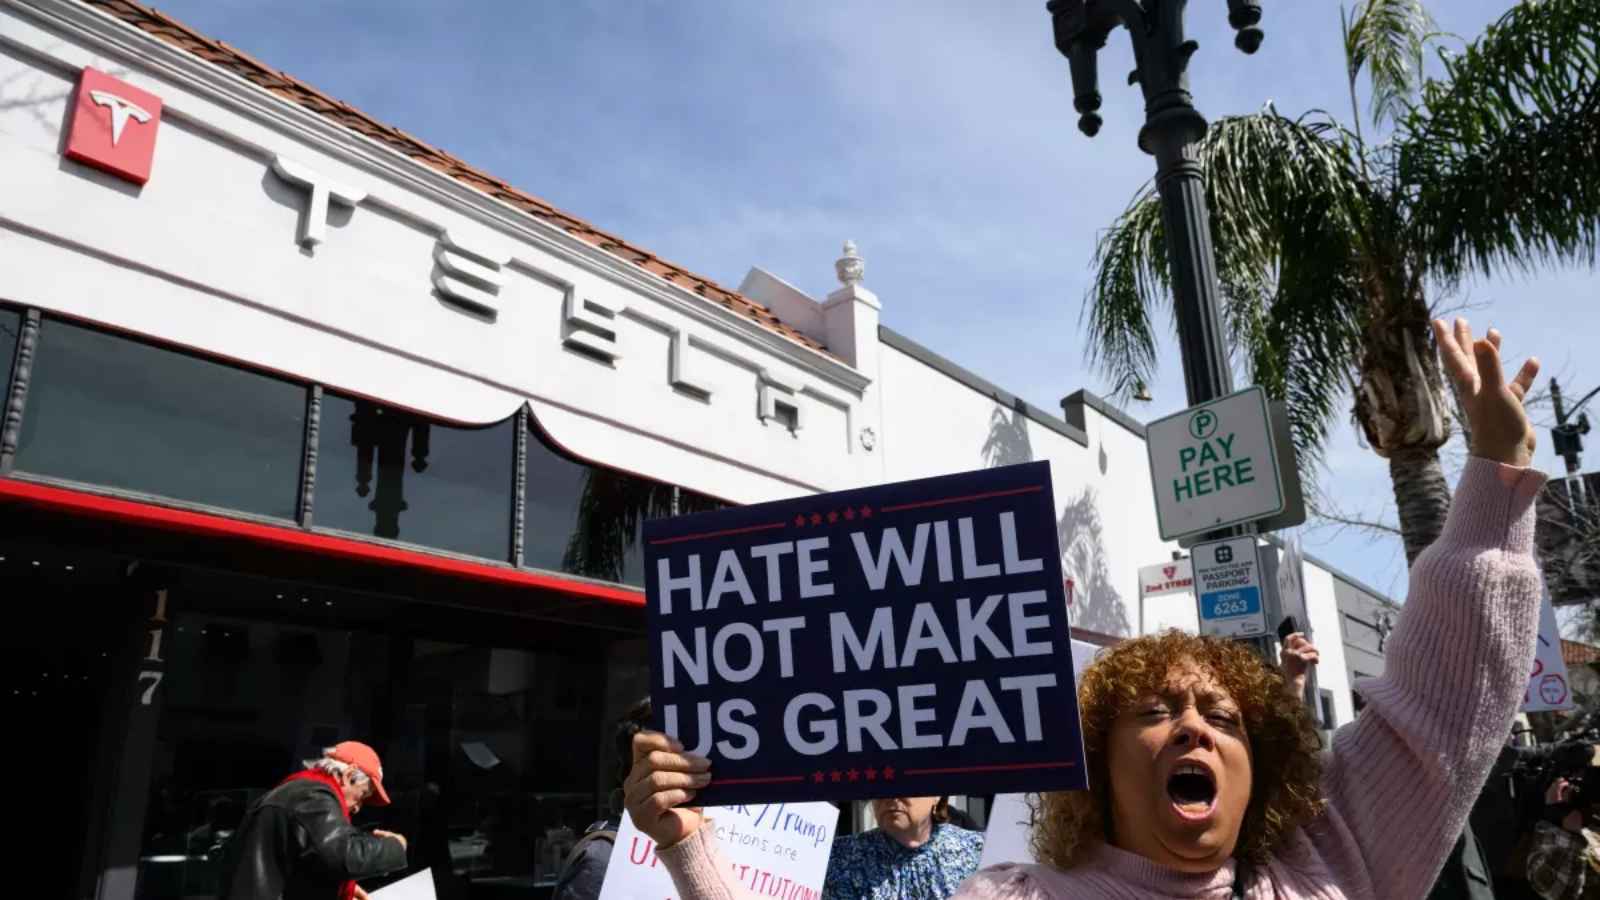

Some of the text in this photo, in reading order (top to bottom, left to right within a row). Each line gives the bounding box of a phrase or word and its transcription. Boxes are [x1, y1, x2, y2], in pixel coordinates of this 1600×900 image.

[270, 153, 805, 435] TESLA
[1179, 432, 1235, 472] PAY
[1173, 457, 1255, 502] HERE
[656, 511, 1044, 615] HATE WILL
[1203, 568, 1250, 581] PASSPORT
[1164, 577, 1193, 590] STREE
[1206, 576, 1250, 591] PARKING
[1214, 599, 1248, 616] 6263
[660, 589, 1054, 689] NOT MAKE
[663, 673, 1058, 761] US GREAT
[715, 824, 769, 851] ctions
